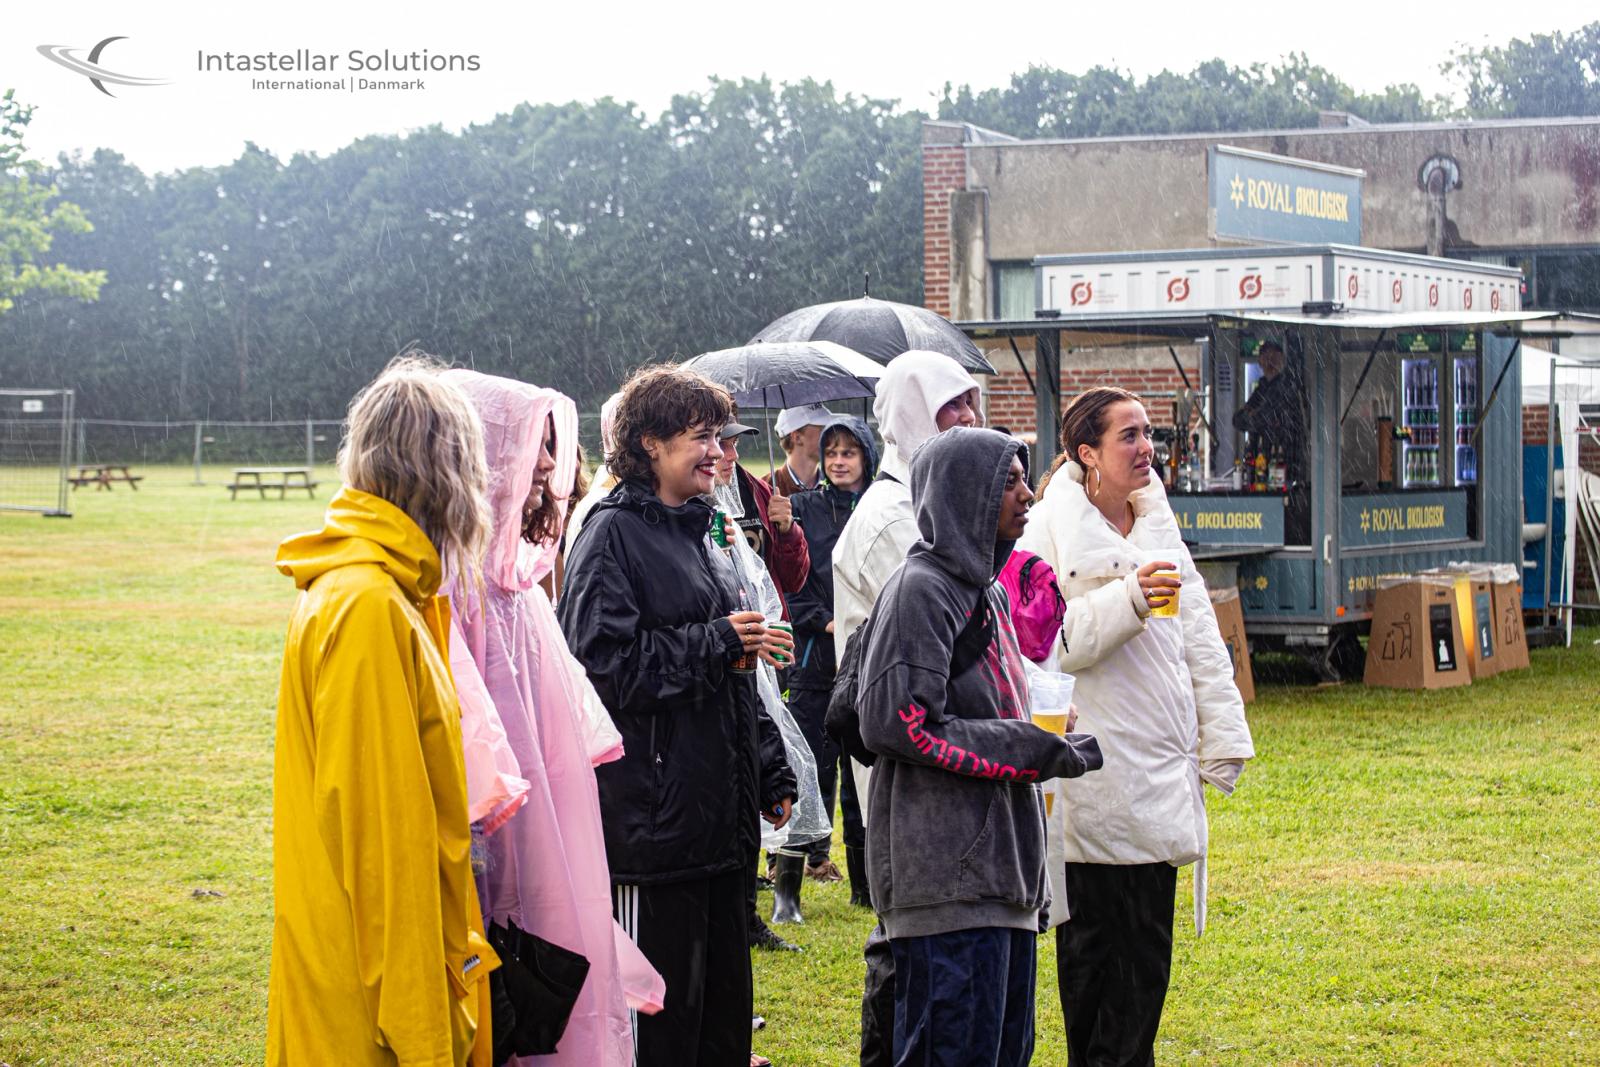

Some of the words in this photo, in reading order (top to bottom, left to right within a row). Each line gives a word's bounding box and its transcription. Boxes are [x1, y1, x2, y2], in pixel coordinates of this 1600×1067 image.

[1247, 178, 1293, 214] ROYAL
[1295, 186, 1348, 222] ØKOLOGISK
[1196, 512, 1262, 529] ØKOLOGISK
[1371, 507, 1405, 532] ROYAL
[1406, 505, 1445, 529] ØKOLOGISK
